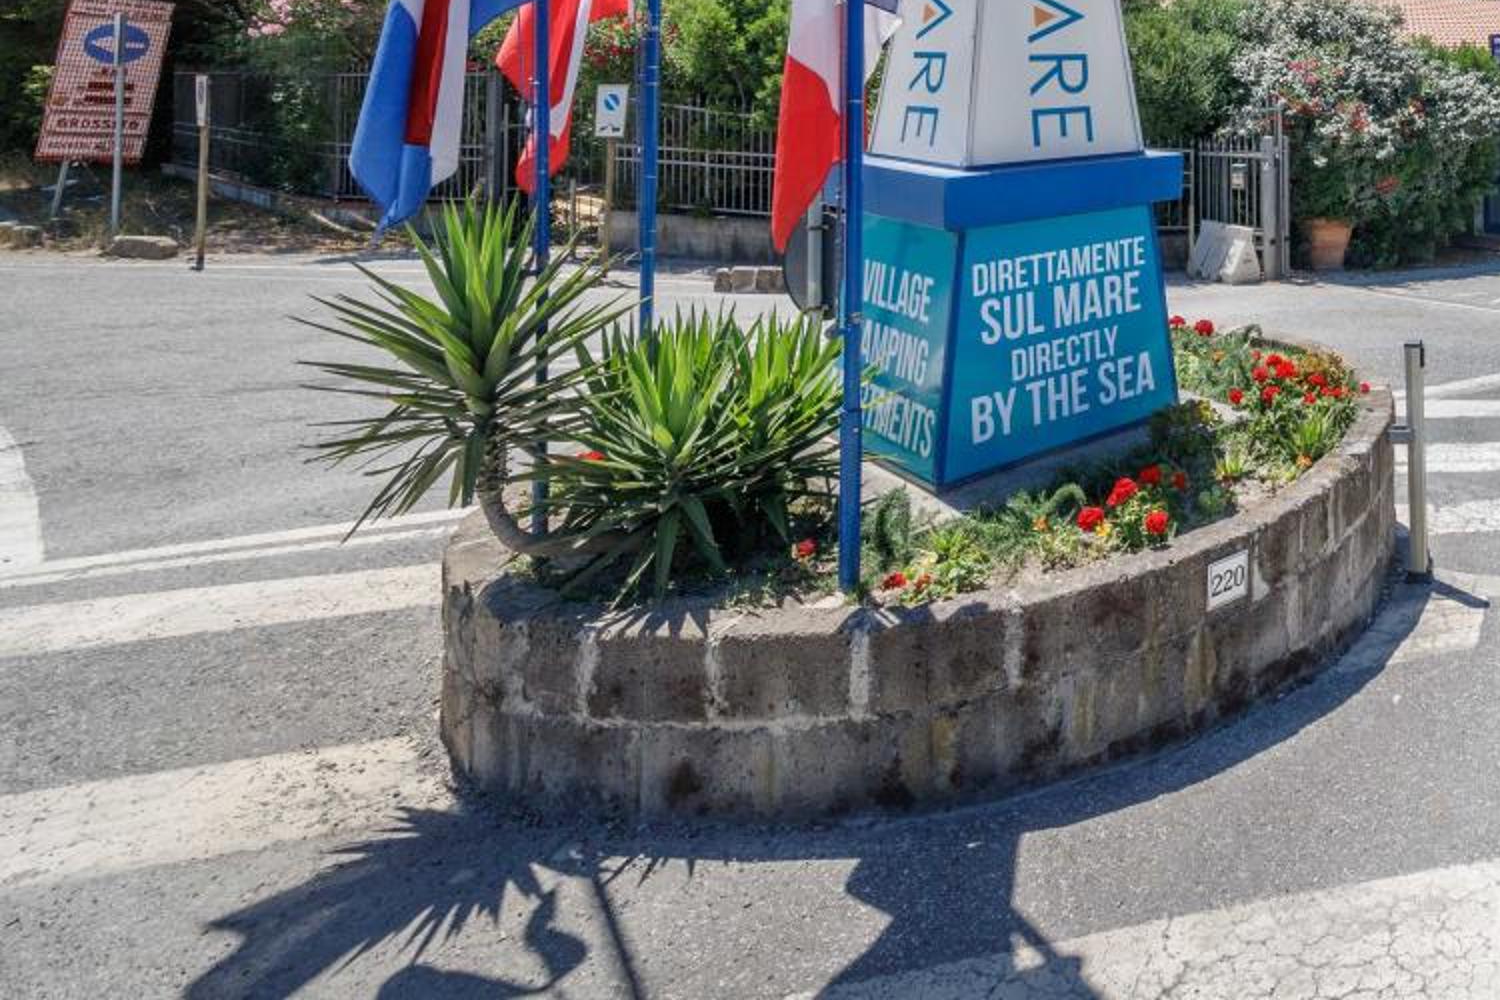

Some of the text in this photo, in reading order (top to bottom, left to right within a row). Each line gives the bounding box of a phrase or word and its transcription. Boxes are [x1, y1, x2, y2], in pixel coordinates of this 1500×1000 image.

[56, 117, 140, 131] GROSSTO
[863, 259, 934, 324] VILLAGE
[972, 236, 1146, 298] DIRETTAMENTE
[980, 270, 1142, 346] SUL MARE
[861, 318, 929, 387] AMPING
[1010, 326, 1119, 382] DIRECTLY
[971, 351, 1155, 445] BY THE SEA
[1211, 564, 1246, 597] 220
